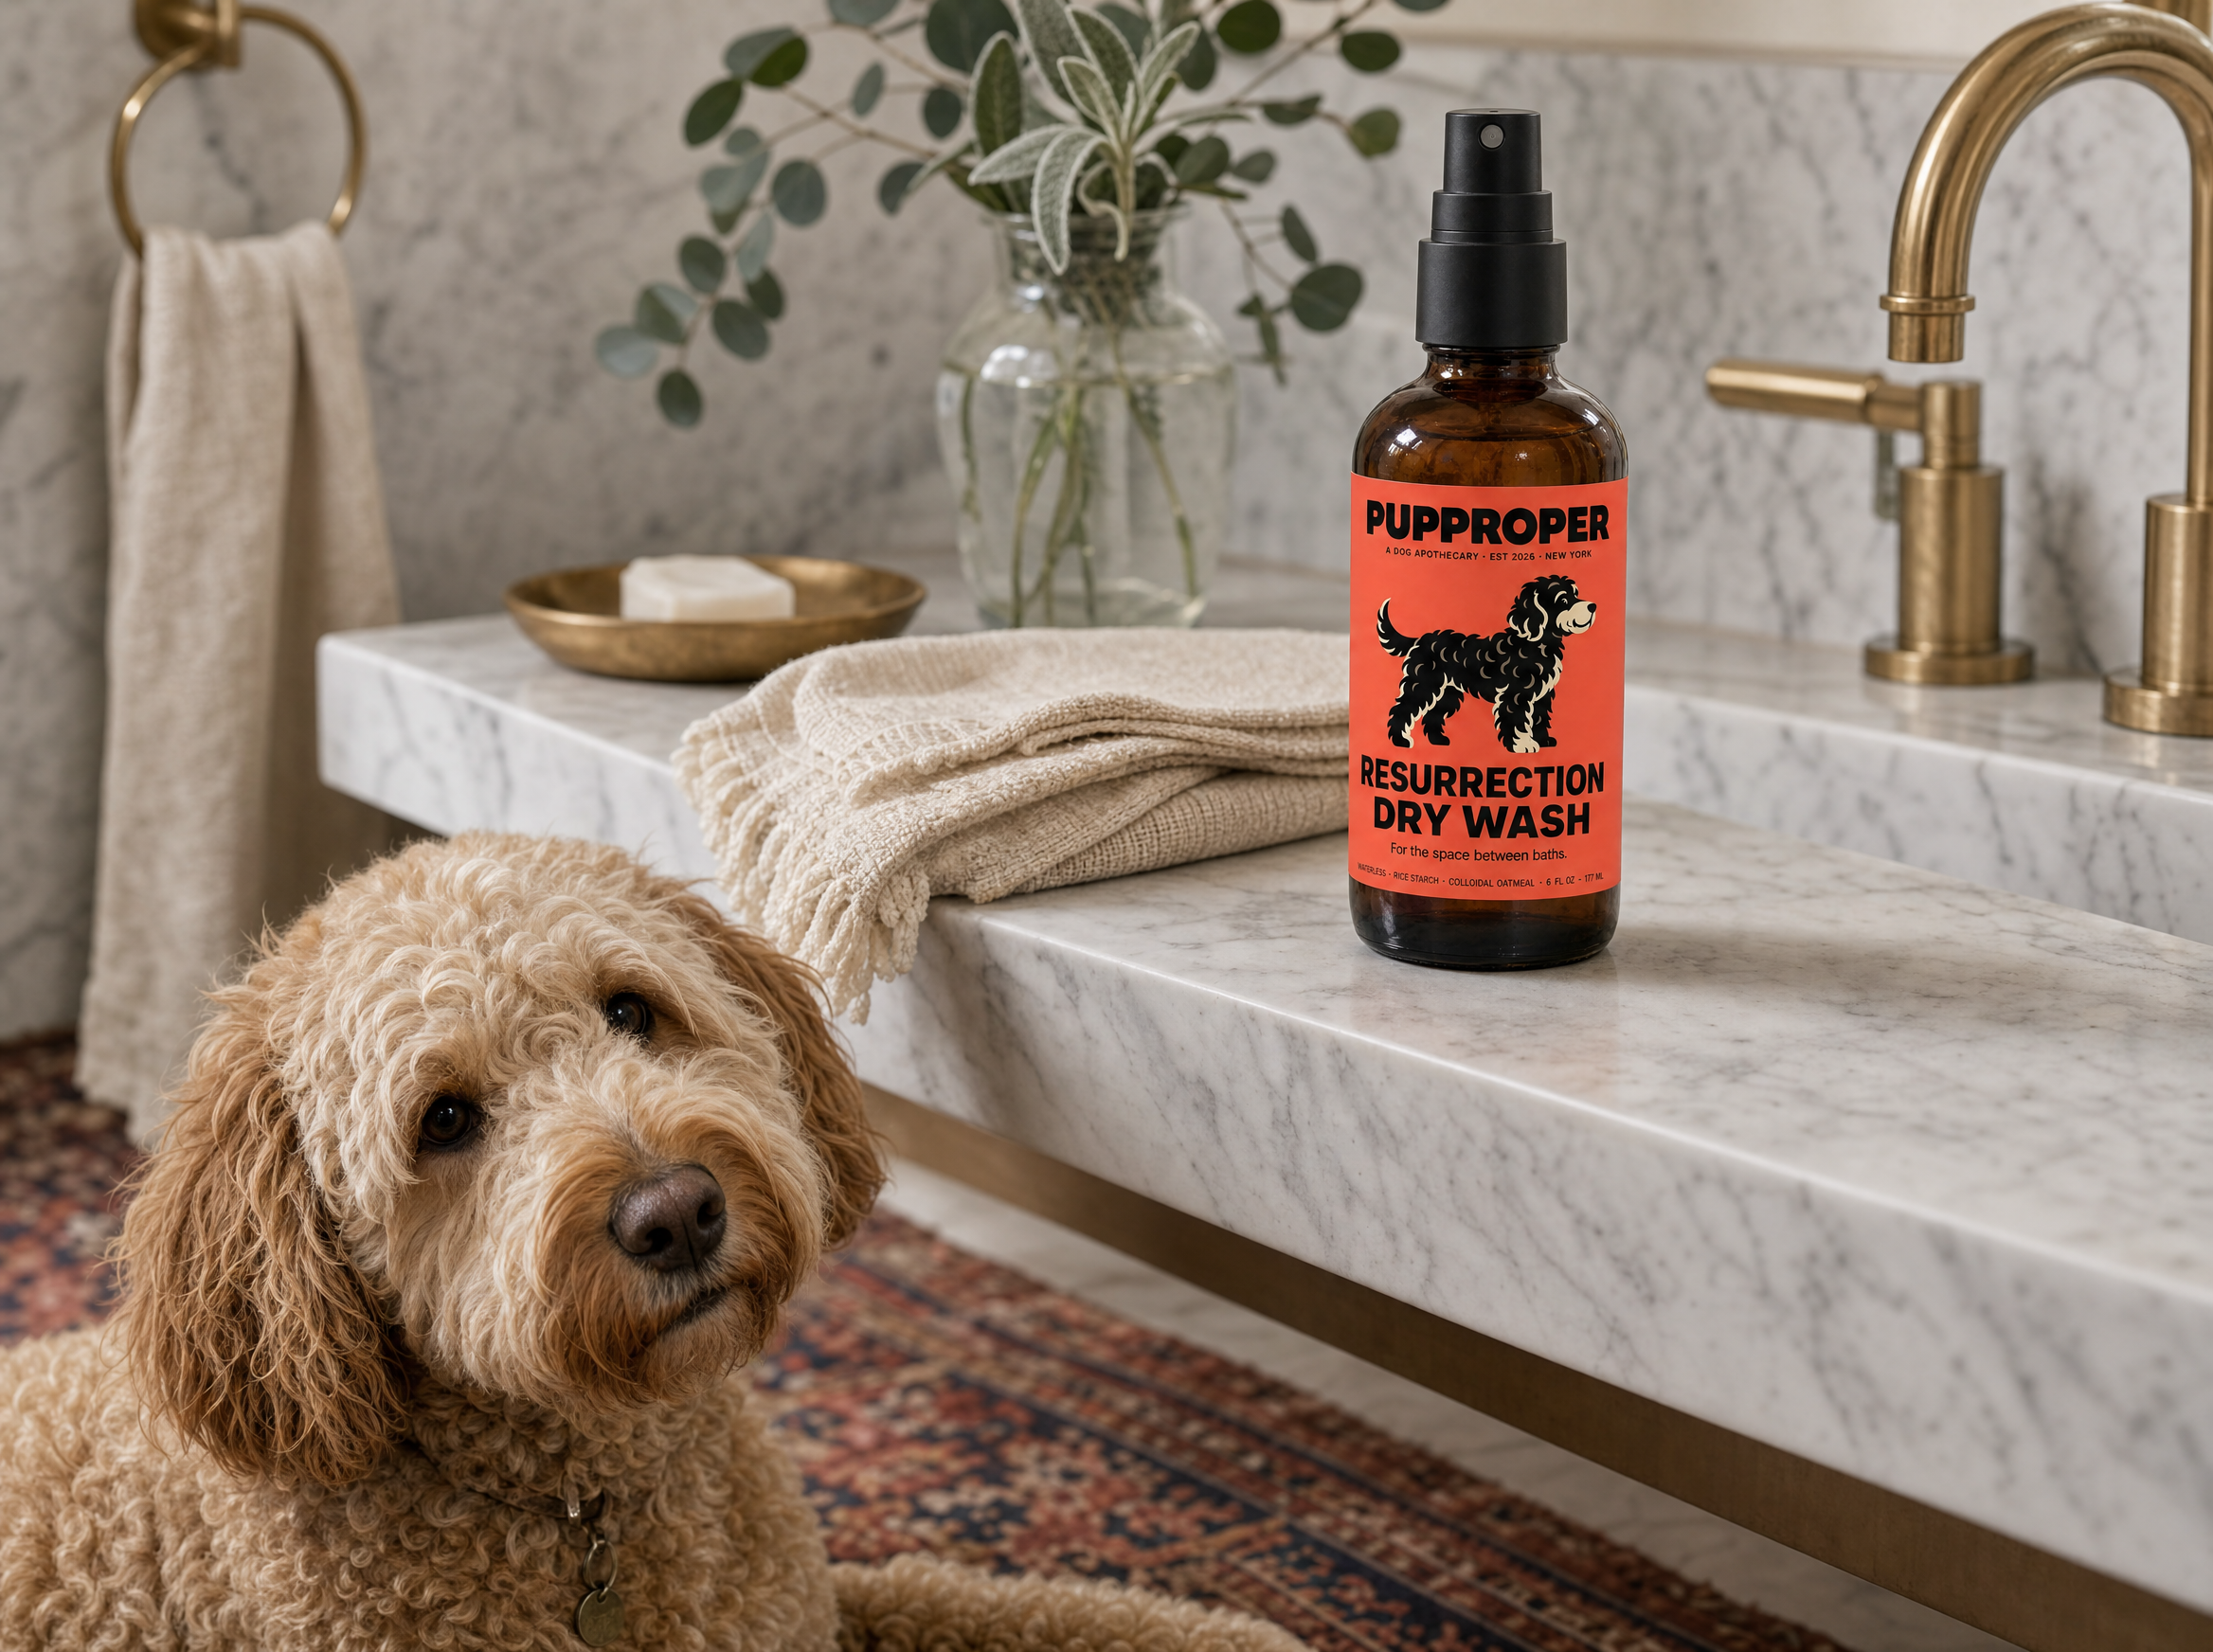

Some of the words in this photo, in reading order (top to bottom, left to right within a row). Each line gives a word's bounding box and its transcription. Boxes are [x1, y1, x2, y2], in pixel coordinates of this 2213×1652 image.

[1366, 499, 1610, 546] PUPPROPER
[1385, 546, 1392, 554] A
[1393, 547, 1412, 557] DOG
[1413, 548, 1480, 561] APOTHECARY
[1489, 552, 1509, 562] EST
[1511, 552, 1536, 562] 2026
[1544, 551, 1567, 561] NEW
[1569, 549, 1592, 560] YORK
[1360, 754, 1605, 799] RESURRECTION
[1374, 796, 1452, 836] DRY
[1462, 801, 1591, 839] WASH
[1391, 841, 1408, 855] For
[1410, 844, 1430, 858] the
[1432, 849, 1470, 863] space
[1473, 848, 1529, 862] between
[1532, 847, 1568, 861] baths.
[1358, 862, 1387, 877] WATERLESS
[1393, 871, 1409, 882] RICE
[1411, 873, 1440, 885] STARCH
[1448, 877, 1495, 888] COLLOIDAL
[1496, 878, 1536, 888] OATMEAL
[1545, 877, 1552, 887] 6
[1554, 876, 1564, 886] FL
[1565, 875, 1575, 885] OZ
[1584, 872, 1594, 883] 177
[1594, 871, 1604, 881] ML
